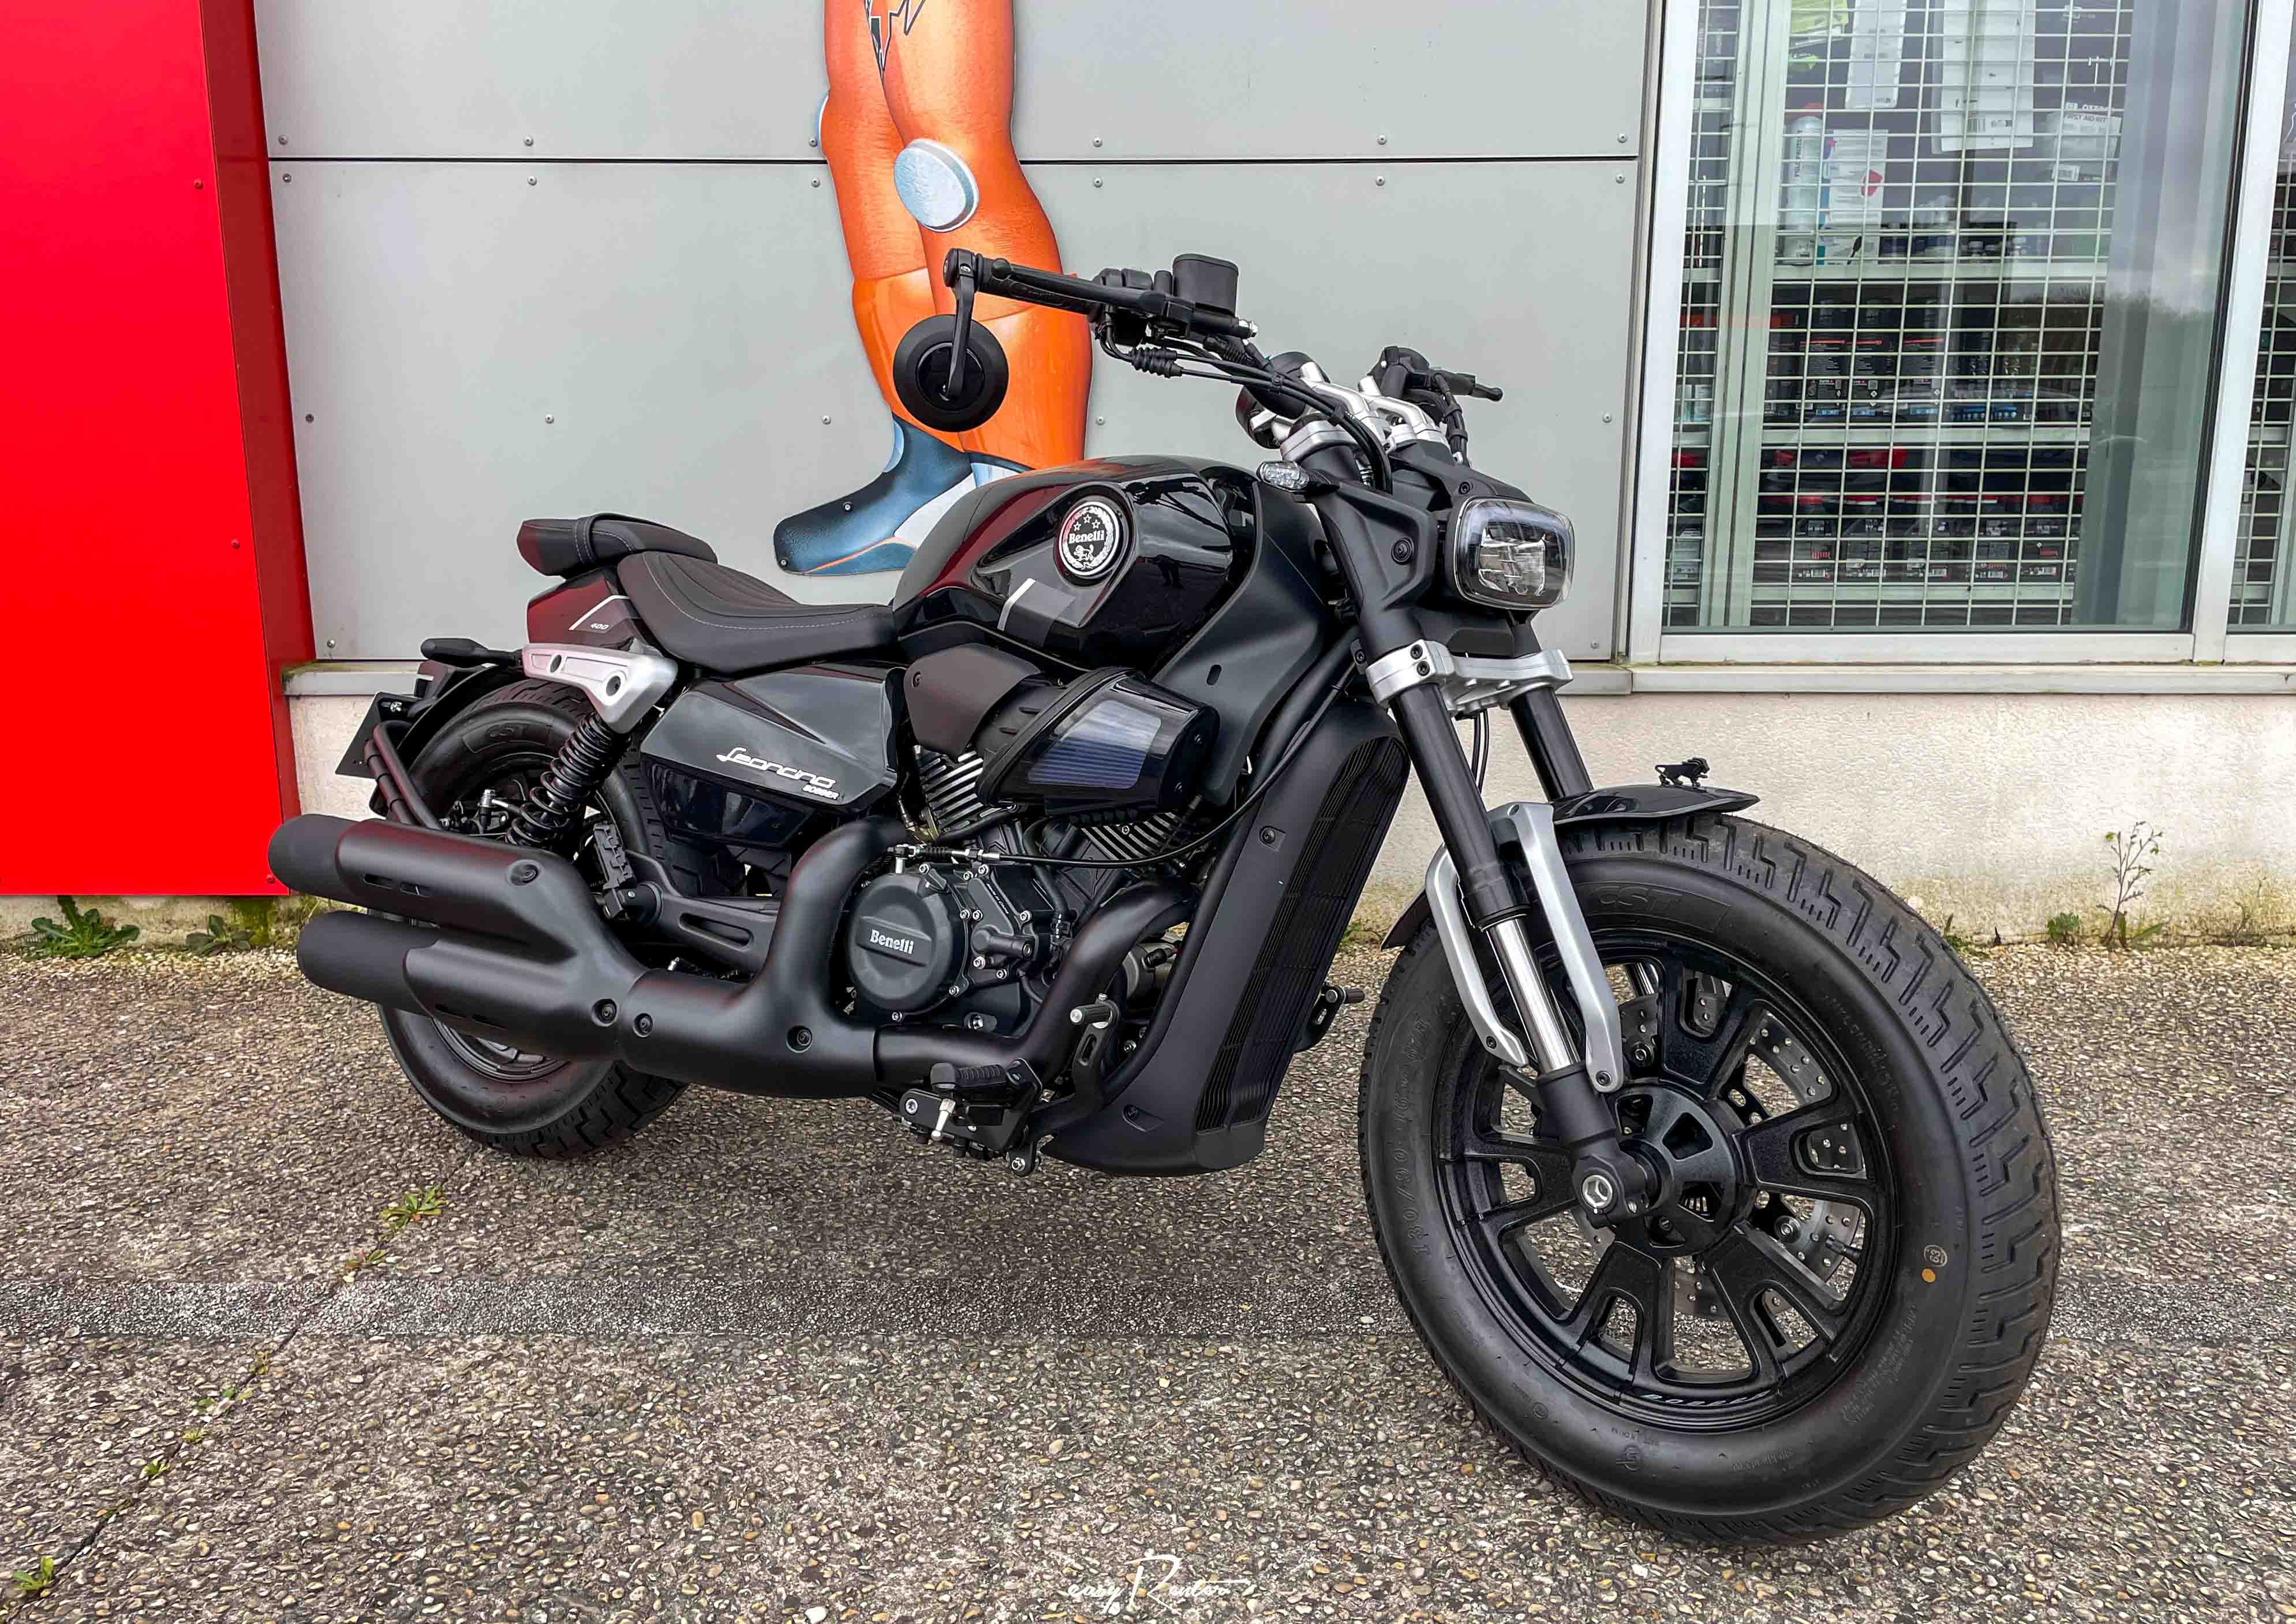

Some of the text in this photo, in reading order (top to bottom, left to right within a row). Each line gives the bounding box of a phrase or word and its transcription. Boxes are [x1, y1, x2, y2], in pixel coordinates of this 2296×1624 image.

[1068, 530, 1105, 543] Benelli
[716, 747, 836, 789] Leoncino
[803, 785, 840, 800] BOBBER
[869, 929, 914, 954] Benelli
